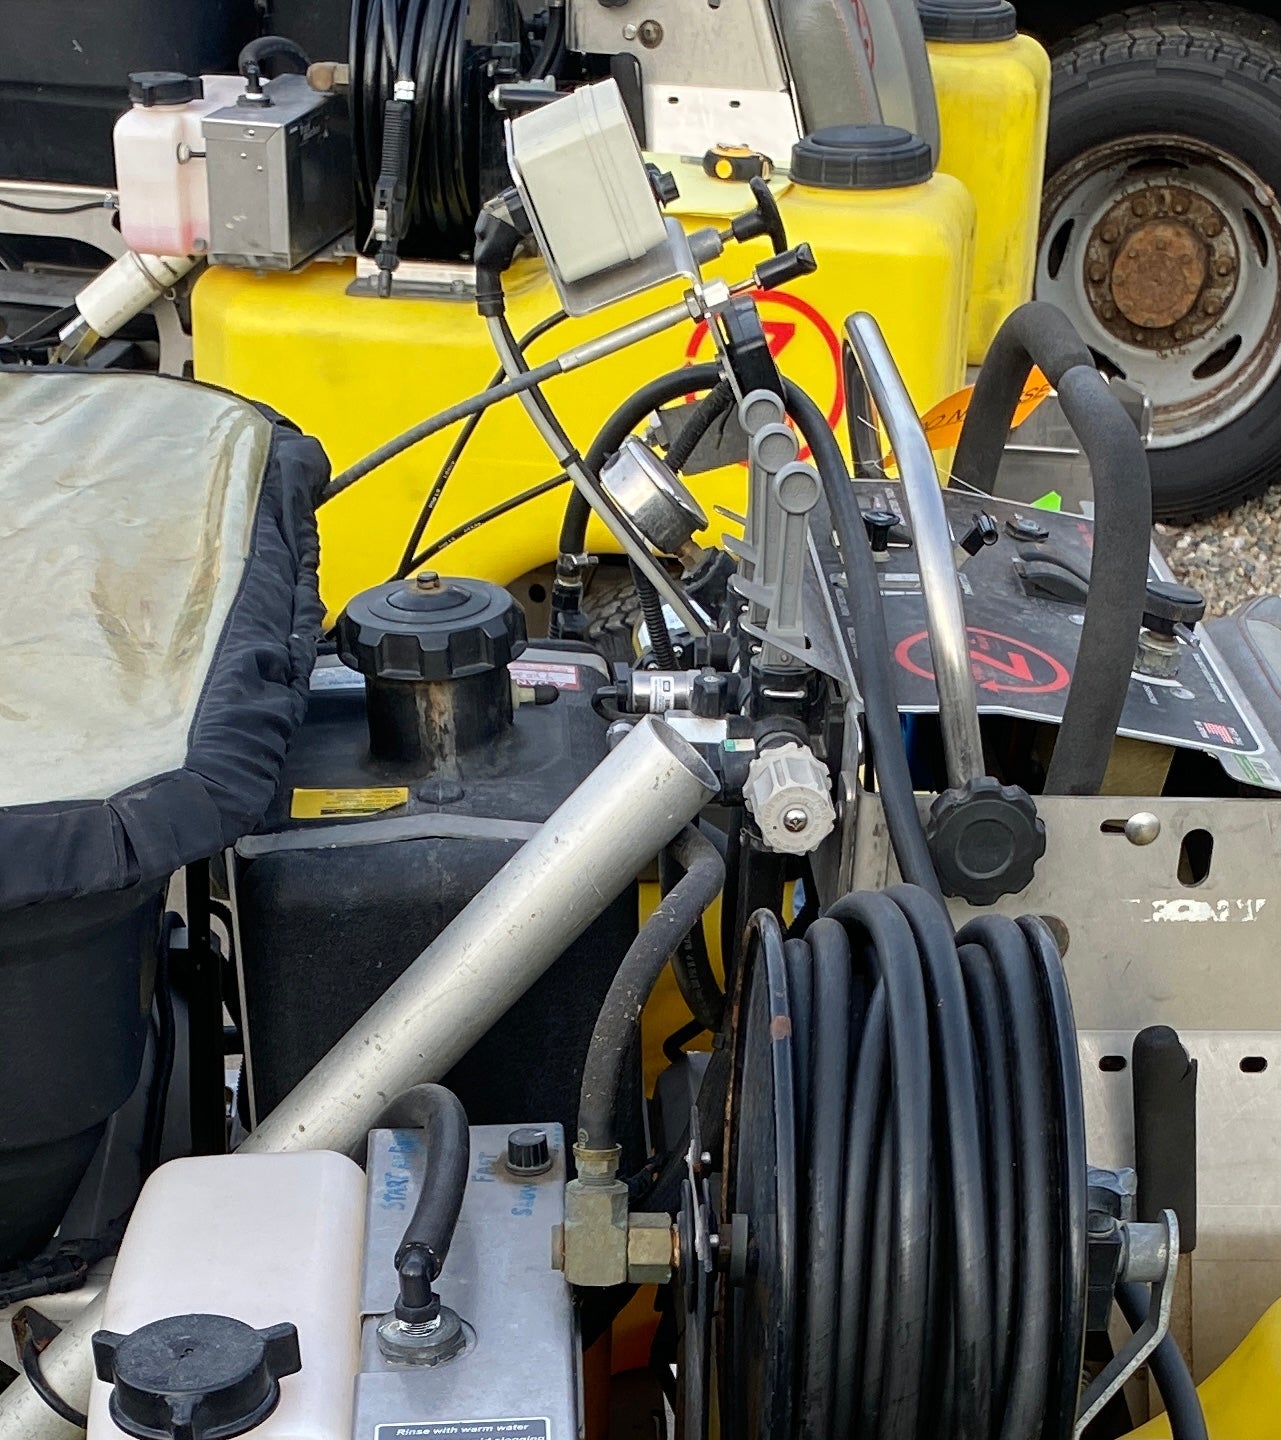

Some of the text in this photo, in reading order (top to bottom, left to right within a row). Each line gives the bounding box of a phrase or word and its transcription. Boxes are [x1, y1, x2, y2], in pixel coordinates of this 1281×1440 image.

[472, 1151, 499, 1182] FAST
[396, 1423, 530, 1436] Rinse with warm water
